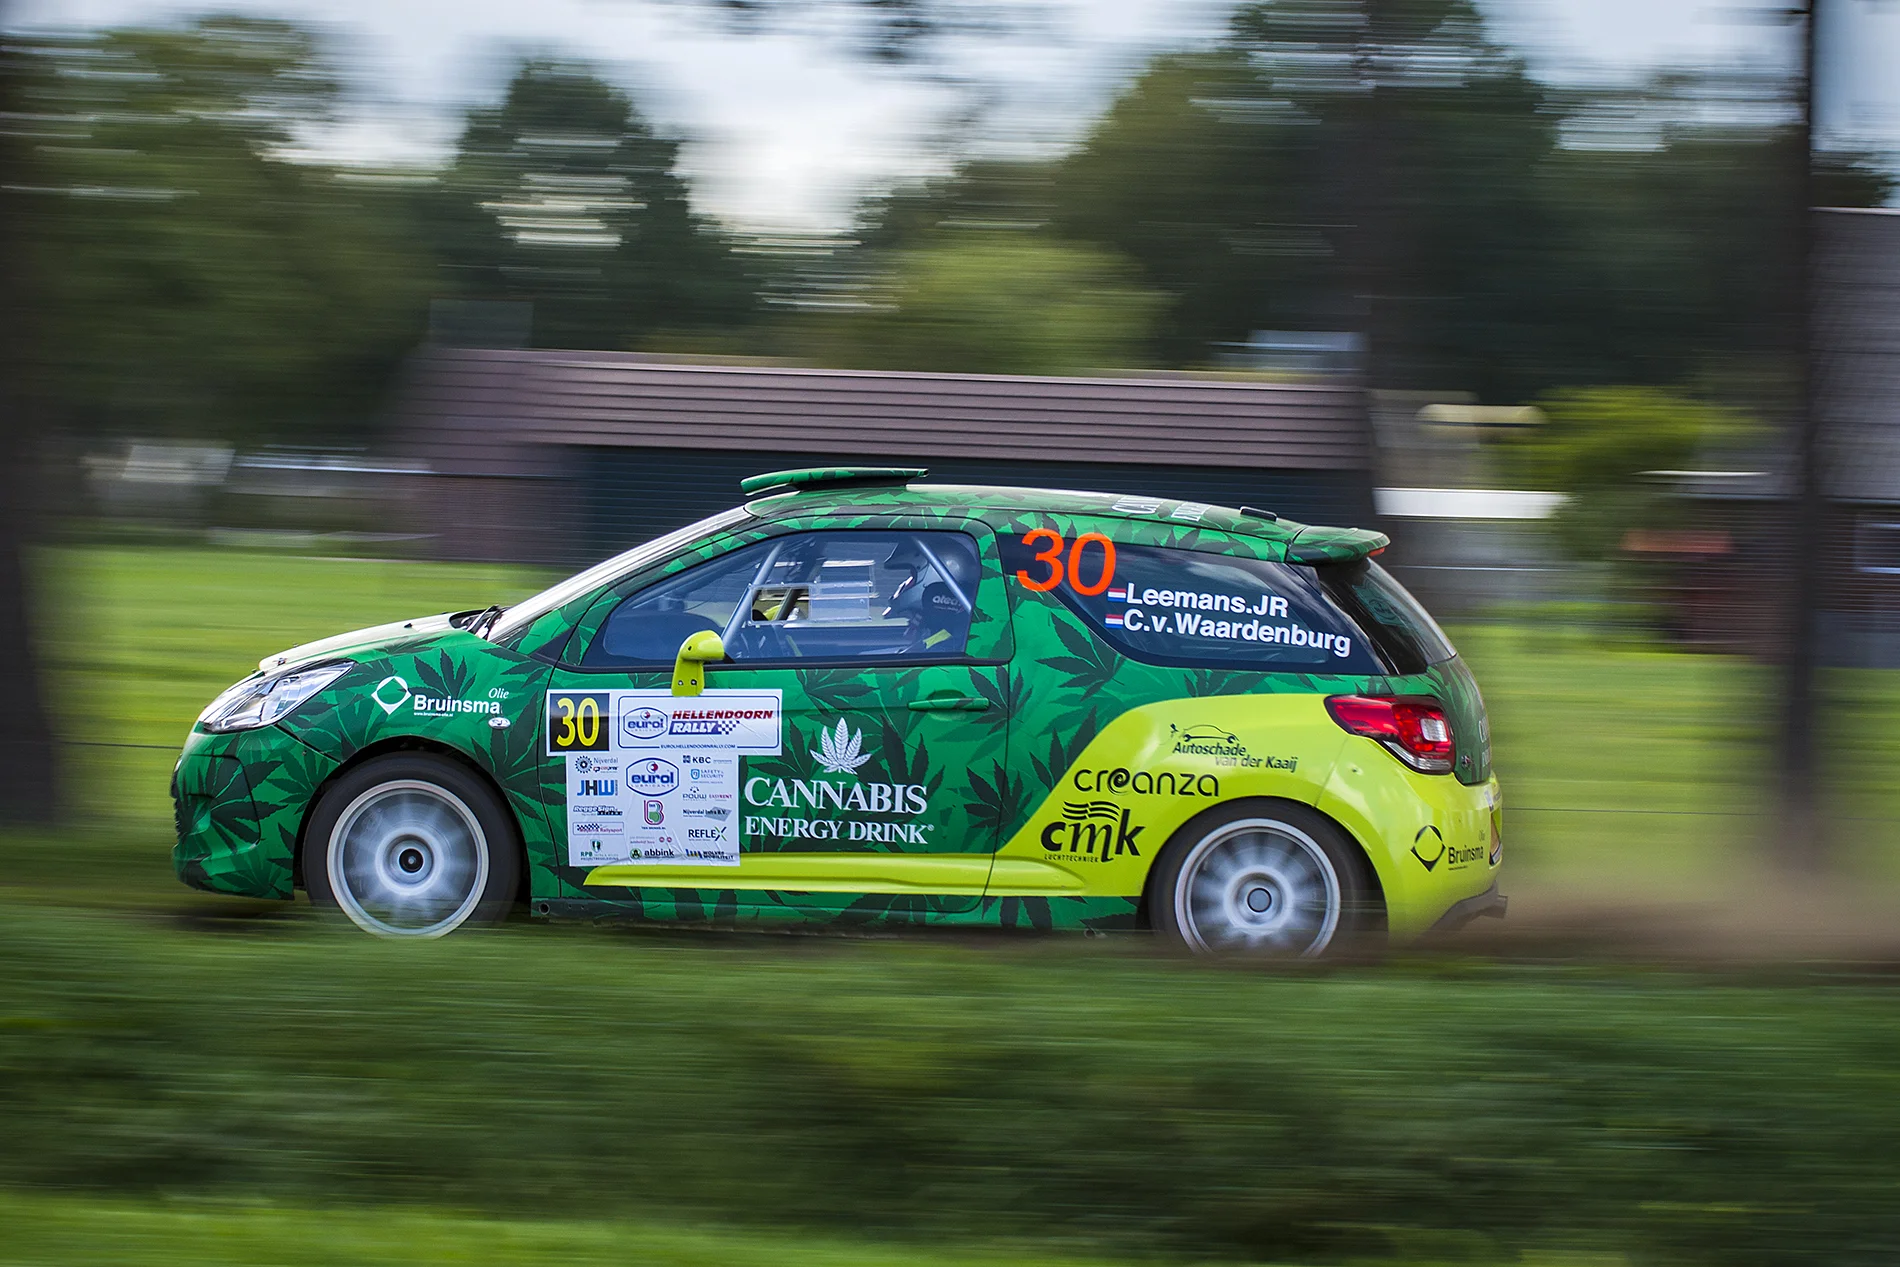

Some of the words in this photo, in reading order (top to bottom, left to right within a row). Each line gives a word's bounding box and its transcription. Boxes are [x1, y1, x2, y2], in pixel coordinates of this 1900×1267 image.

[1016, 528, 1117, 597] 30
[1126, 582, 1289, 618] Leemans.JR
[488, 687, 510, 699] Olie
[414, 694, 501, 714] Bruinsma
[556, 697, 600, 747] 30
[672, 710, 774, 720] HELLENDOORN
[627, 718, 664, 729] eurol
[672, 721, 717, 734] RALLY
[1172, 742, 1247, 757] Autoschade
[593, 757, 619, 765] Nijverdal
[1215, 756, 1238, 767] van
[1241, 754, 1263, 768] der
[1265, 756, 1299, 773] Kaaij
[631, 772, 674, 784] eurol
[577, 780, 614, 796] JHW
[744, 777, 928, 815] CANNABIS
[688, 827, 727, 841] REFLEX
[744, 816, 844, 840] ENERGY
[1040, 808, 1146, 863] cmk
[644, 848, 675, 857] abbink
[1447, 844, 1484, 864] Bruinsma
